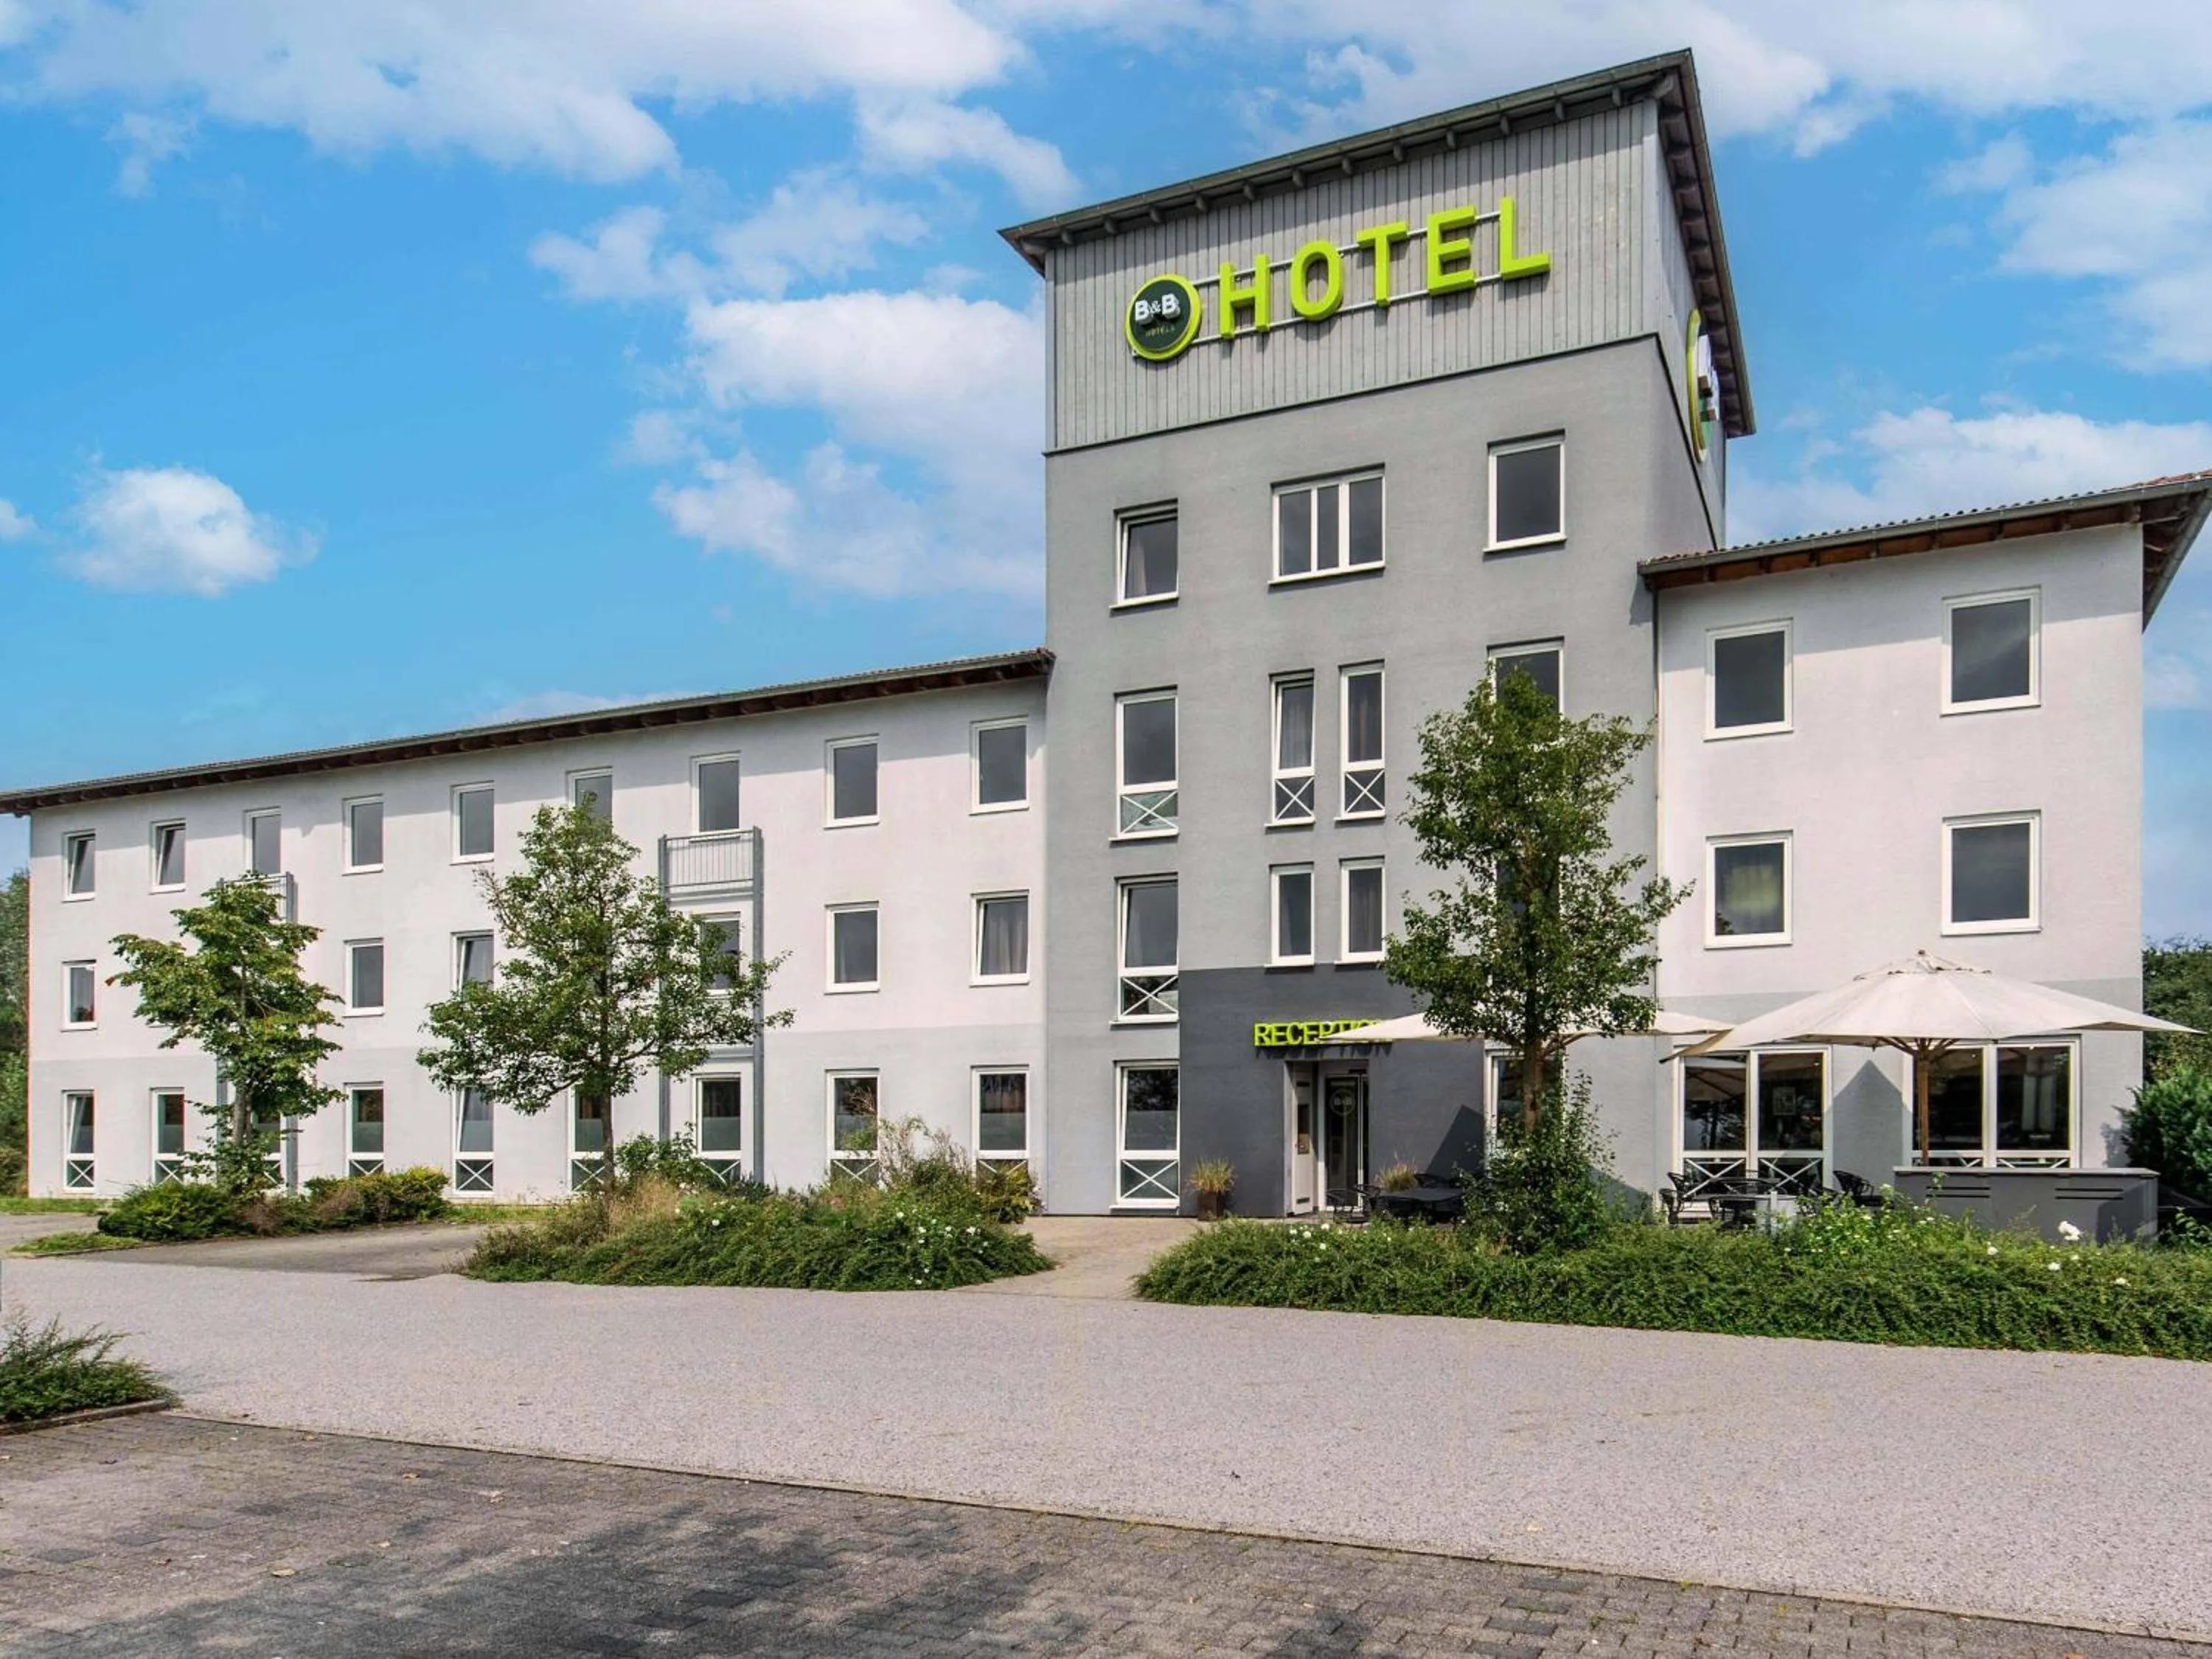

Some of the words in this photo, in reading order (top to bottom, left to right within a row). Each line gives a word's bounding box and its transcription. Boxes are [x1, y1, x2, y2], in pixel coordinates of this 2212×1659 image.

[1219, 197, 1551, 338] HOTEL
[1135, 293, 1180, 324] B&B
[1254, 1019, 1393, 1046] RECEPT
